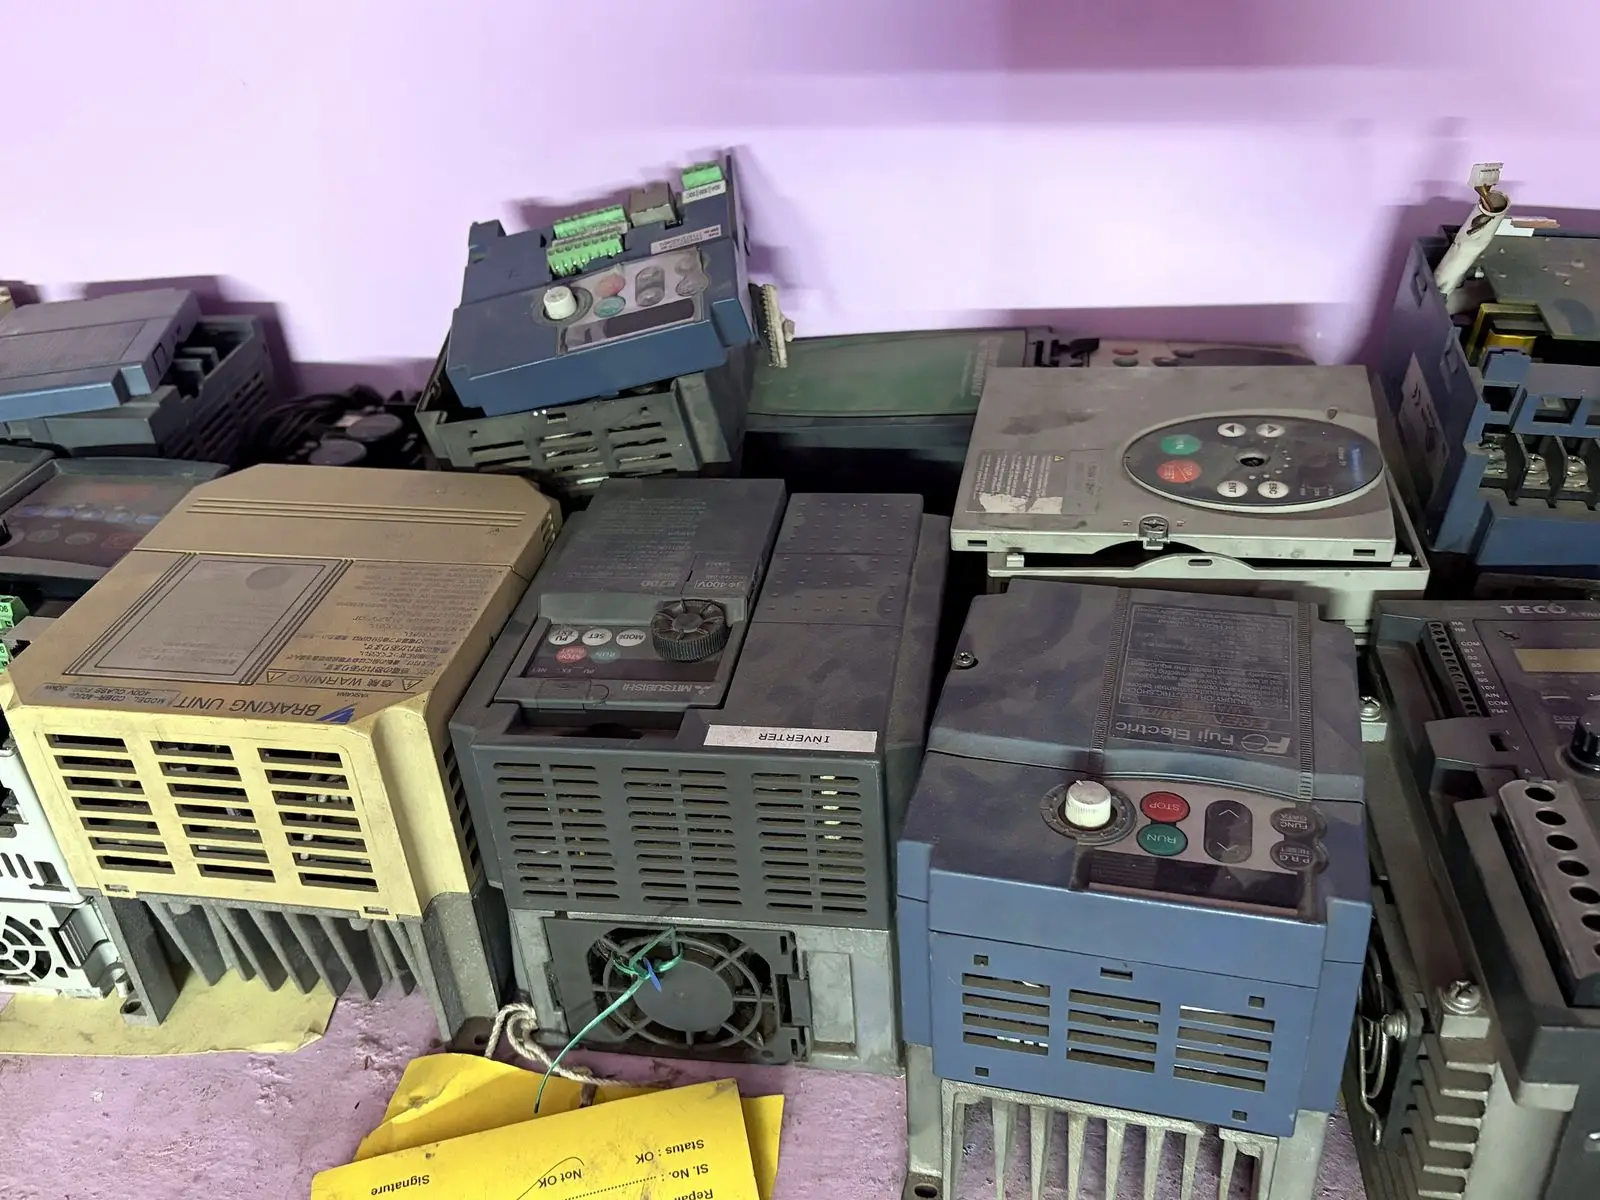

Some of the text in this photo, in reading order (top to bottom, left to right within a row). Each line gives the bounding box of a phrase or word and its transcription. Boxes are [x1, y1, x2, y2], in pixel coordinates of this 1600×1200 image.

[1228, 482, 1236, 494] ENT
[1269, 481, 1278, 496] ESC
[1500, 603, 1566, 614] TECO
[288, 674, 363, 686] WARNING
[622, 683, 692, 692] MITSUBISHI
[133, 696, 166, 705] MODEL
[173, 695, 321, 717] BRAKING UNIT
[758, 731, 830, 745] INVERTER
[1115, 721, 1234, 744] Fuji Electric
[1148, 801, 1180, 810] STOP
[1279, 821, 1308, 830] FUNC
[1146, 833, 1177, 844] RUN
[665, 1139, 704, 1155] Status
[635, 1151, 654, 1164] OK
[560, 1168, 582, 1181] Not
[668, 1168, 689, 1180] No.
[693, 1163, 709, 1175] Sl.
[370, 1173, 430, 1198] Signature
[537, 1175, 557, 1188] OK
